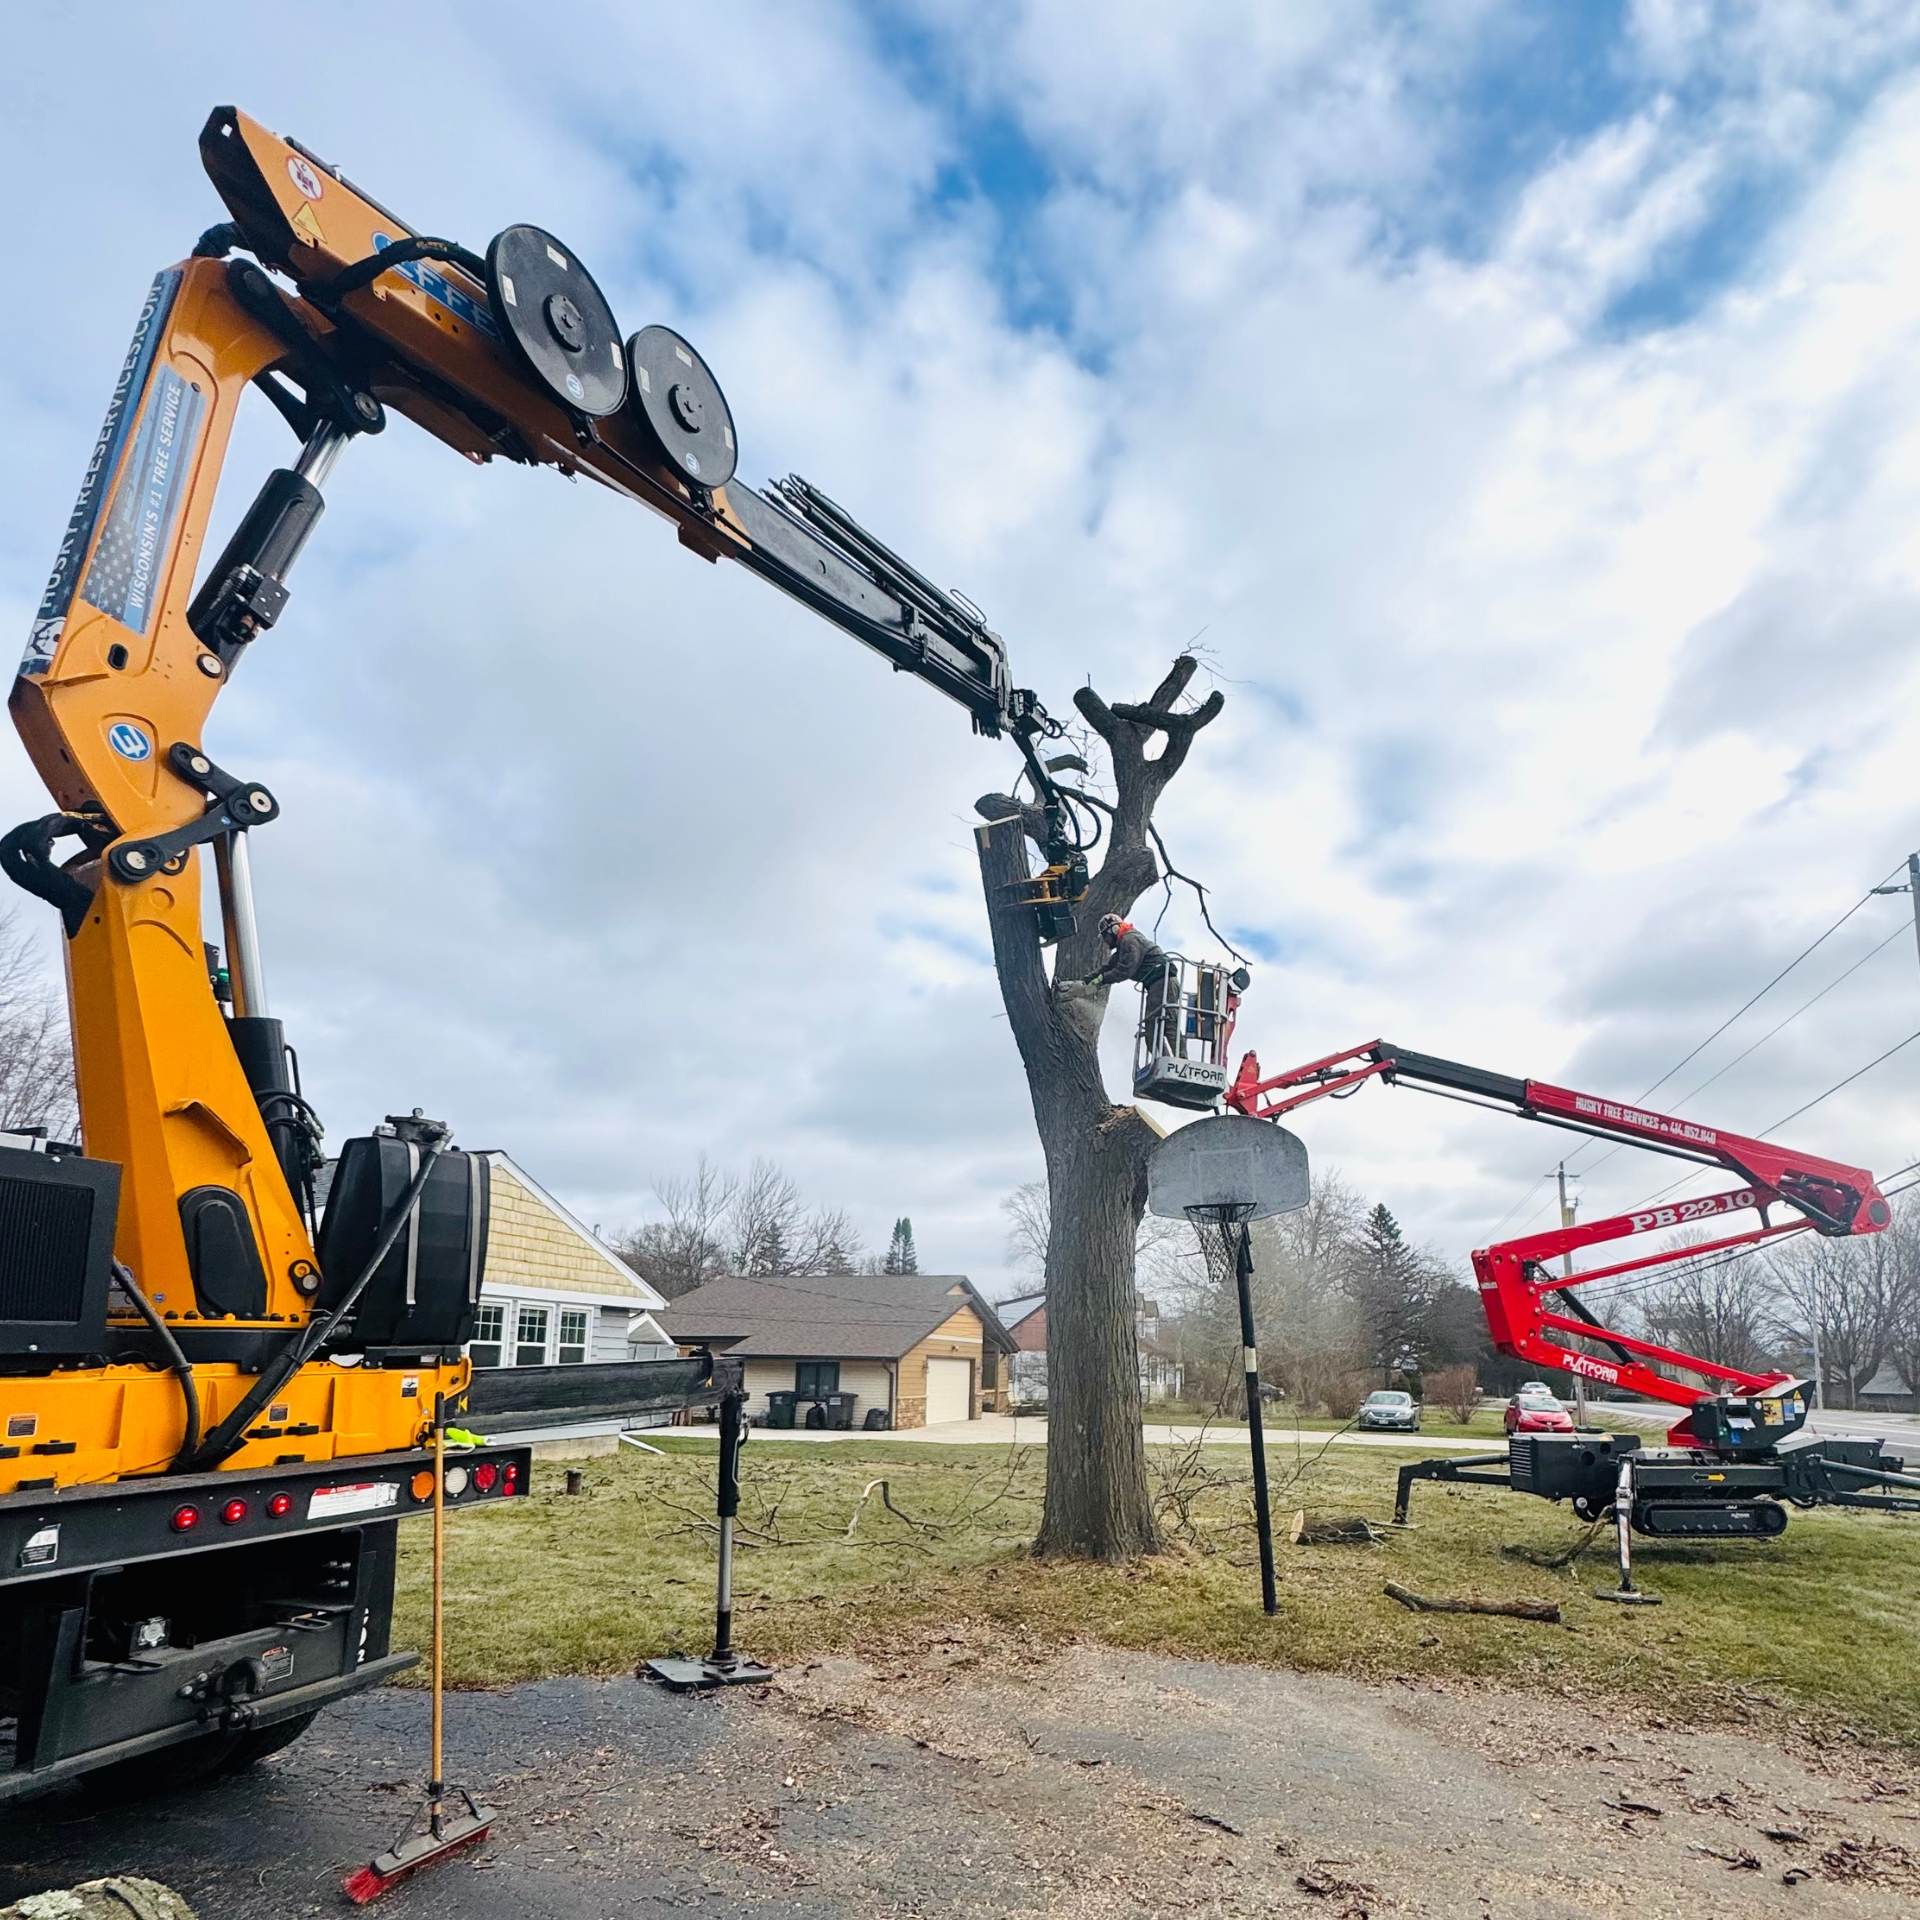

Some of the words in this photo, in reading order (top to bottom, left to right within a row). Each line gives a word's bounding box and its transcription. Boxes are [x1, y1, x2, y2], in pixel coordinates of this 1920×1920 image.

[159, 382, 182, 447] SERVICE
[152, 447, 170, 487] TREE
[149, 489, 163, 508] #1
[130, 509, 158, 609] WISCONSIN'S
[1167, 1063, 1224, 1081] PLATFORM
[1575, 1097, 1602, 1115] HUSKY
[1604, 1103, 1622, 1120] TREE
[1623, 1109, 1660, 1130] SERVICES
[1680, 1191, 1756, 1220] 22.10
[1563, 1354, 1618, 1381] PLATFORM
